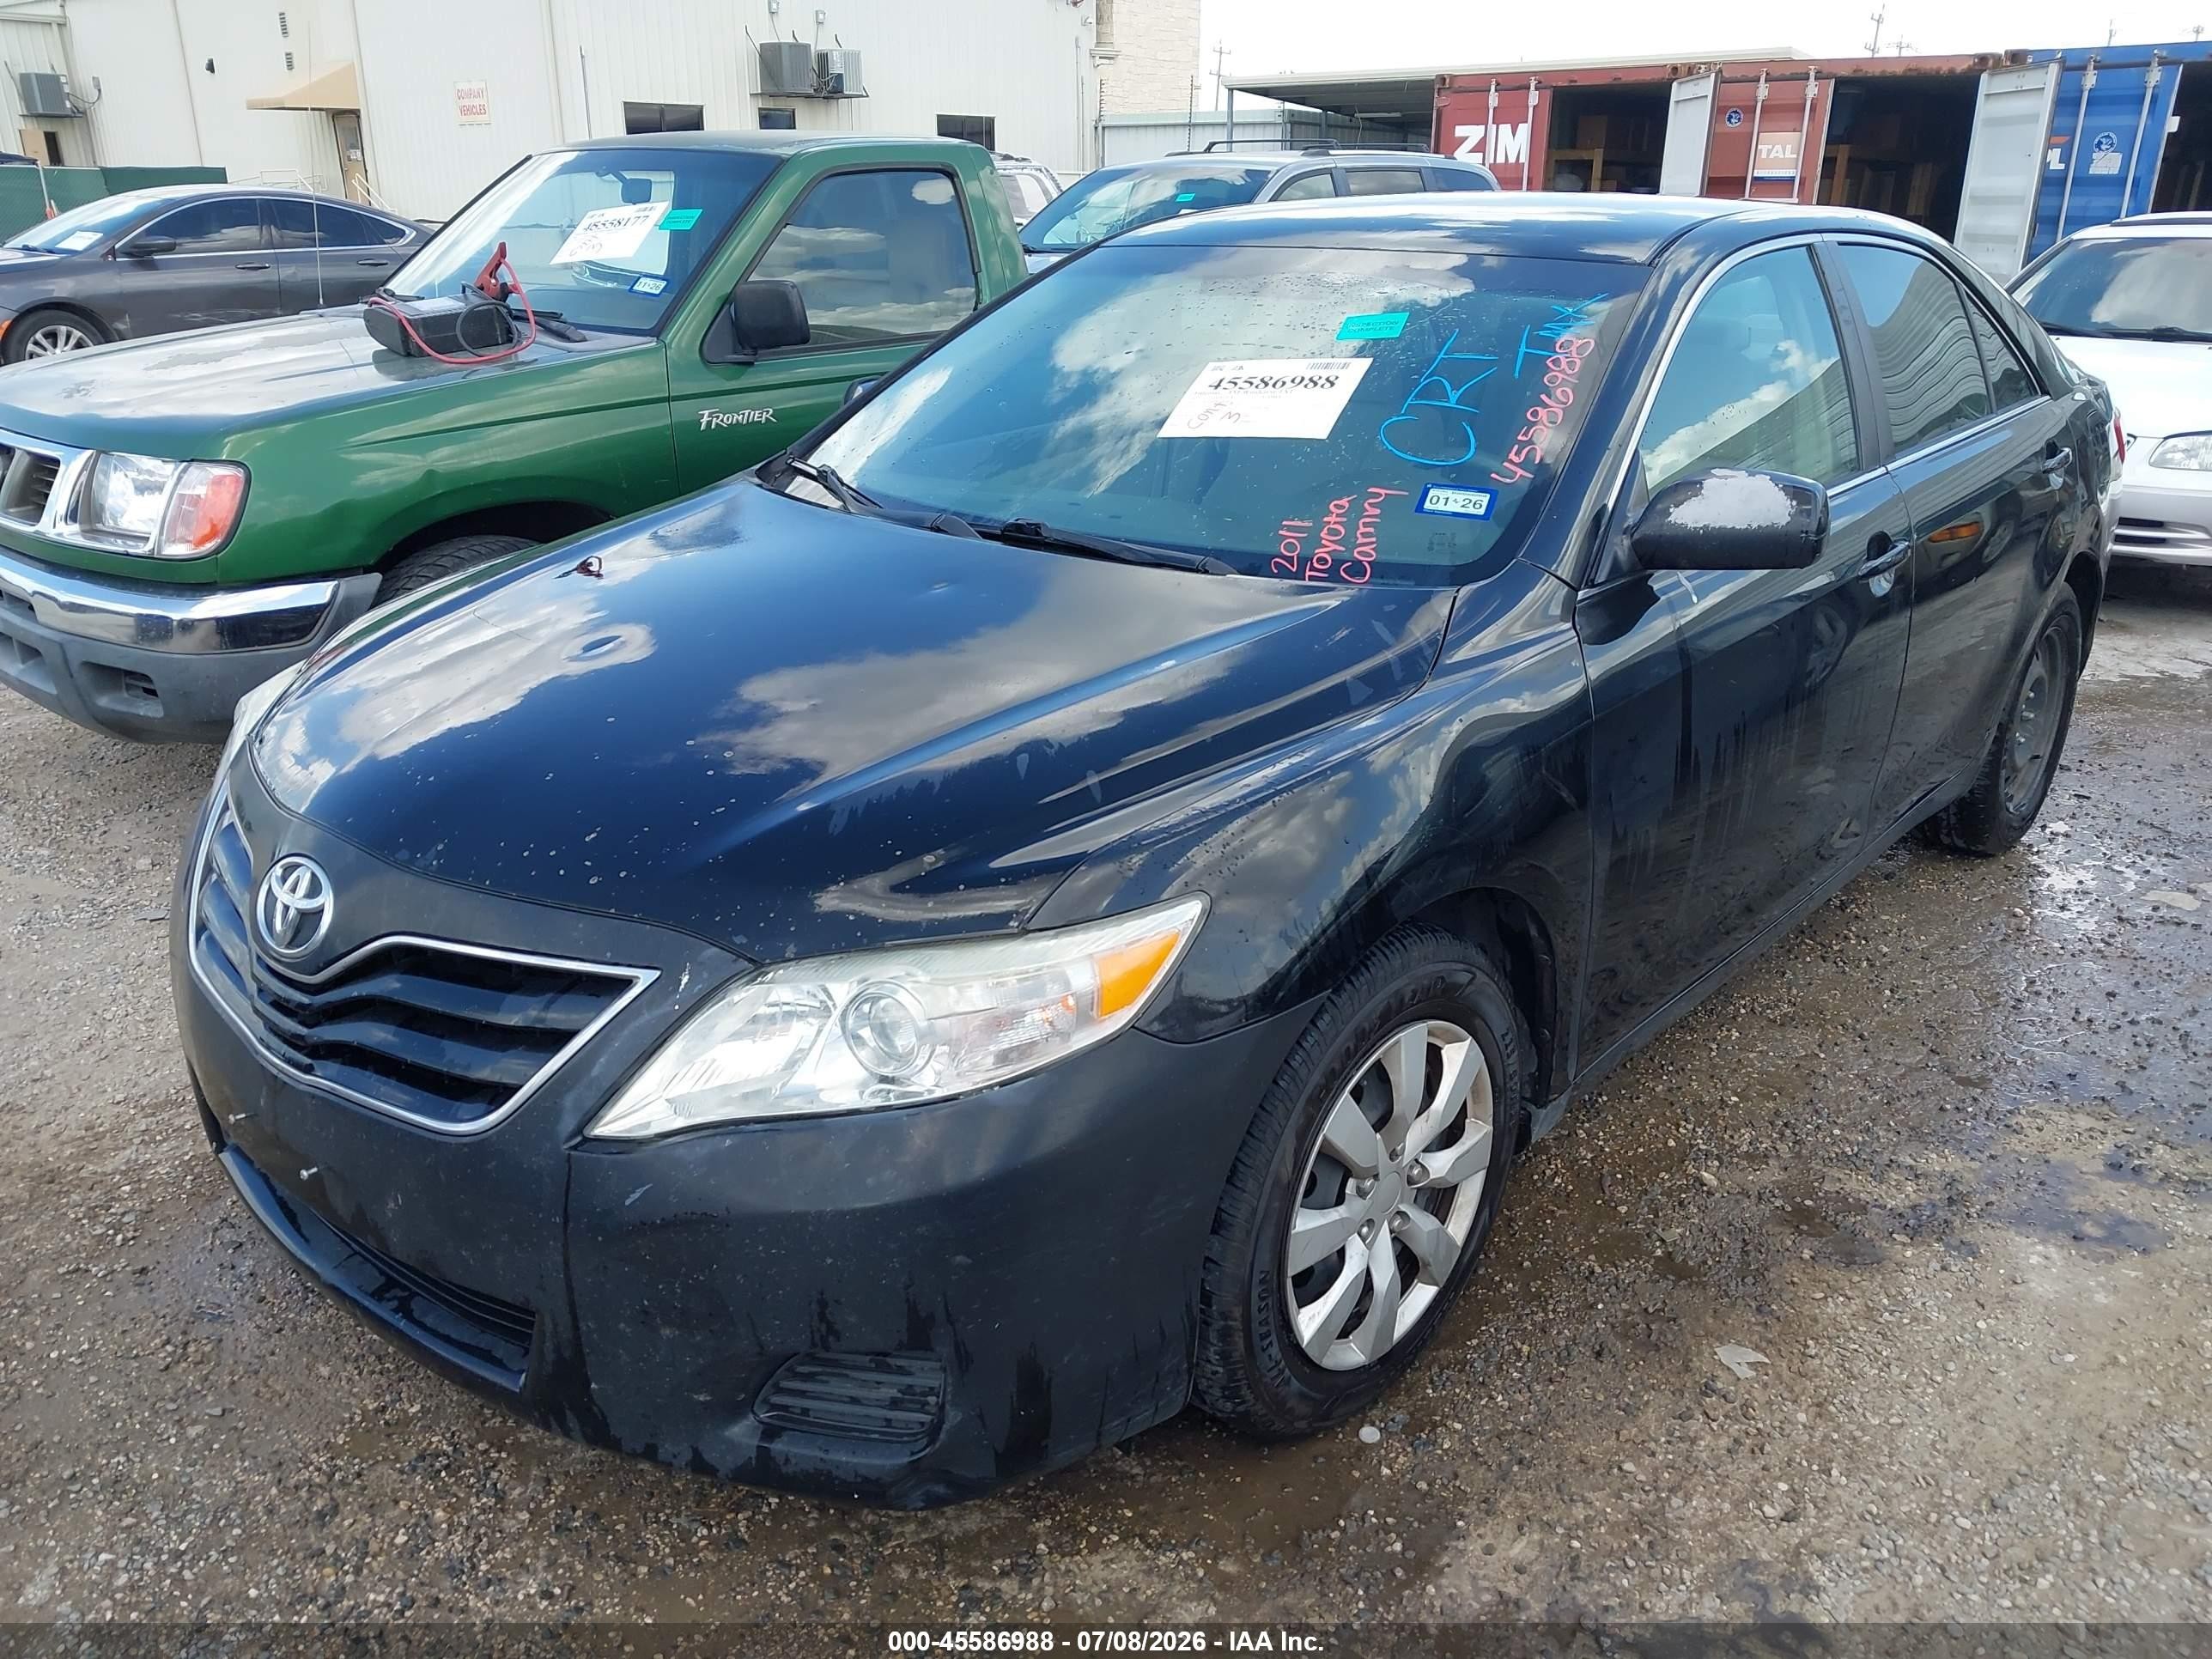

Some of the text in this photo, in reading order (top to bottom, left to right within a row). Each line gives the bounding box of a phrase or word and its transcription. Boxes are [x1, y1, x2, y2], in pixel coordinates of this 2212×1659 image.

[457, 87, 484, 100] COMPANY
[459, 104, 487, 117] VEHICLES
[1454, 123, 1528, 164] ZIM
[1758, 144, 1797, 159] TAL
[1208, 374, 1340, 391] 45586988
[698, 408, 777, 431] FRONTIER
[1490, 337, 1595, 483] 45586988
[1271, 520, 1313, 574] 2011
[1305, 495, 1358, 581] Toyota
